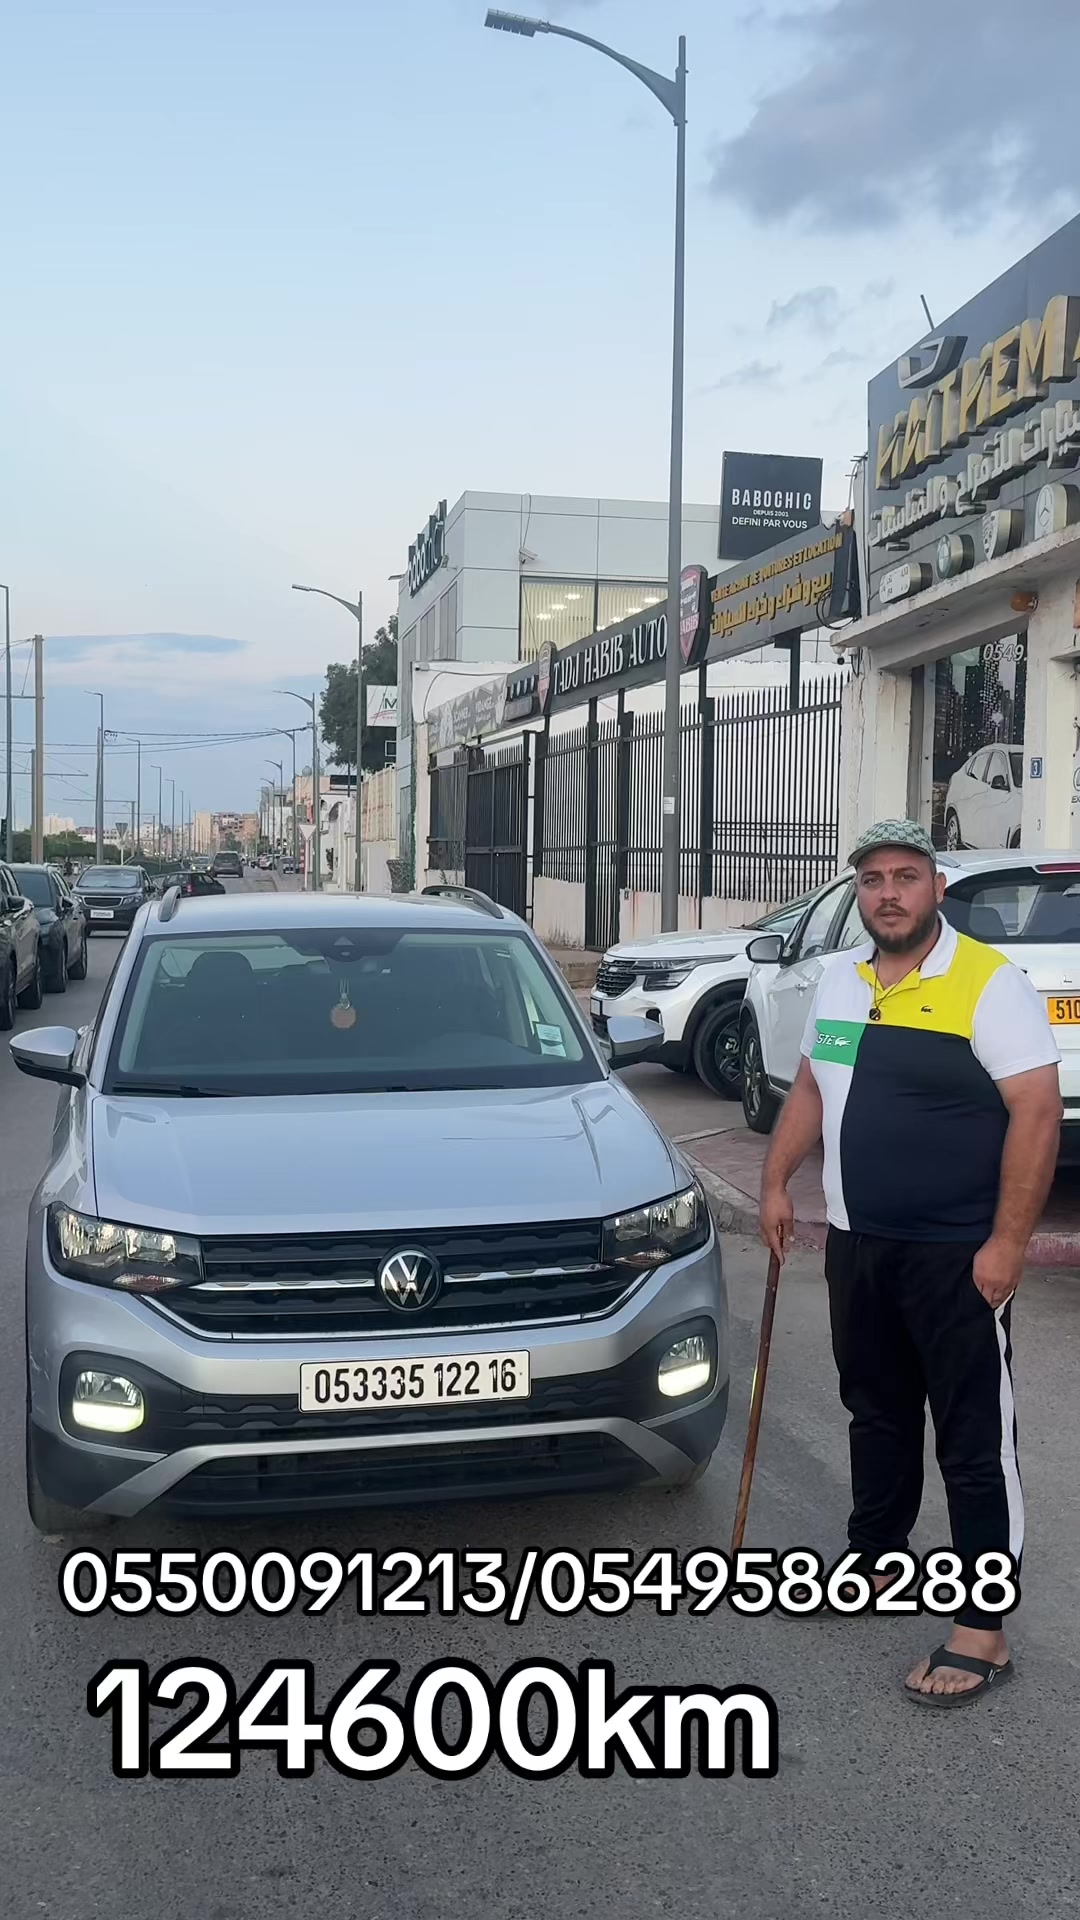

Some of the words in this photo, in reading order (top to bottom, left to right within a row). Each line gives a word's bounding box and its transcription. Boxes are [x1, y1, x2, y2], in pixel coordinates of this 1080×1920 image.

[731, 488, 812, 510] BABOCHIC
[732, 516, 761, 527] DEFINI
[763, 519, 781, 528] PAR
[782, 520, 808, 529] VOUS
[753, 509, 774, 517] DEPUIS
[804, 532, 843, 563] LOCATION
[553, 652, 580, 696] TADJ
[583, 633, 624, 684] HABIB
[628, 614, 667, 668] AUTO
[983, 643, 1024, 662] 0549
[314, 1363, 425, 1403] 053335
[433, 1360, 480, 1397] 122
[488, 1358, 516, 1393] 16
